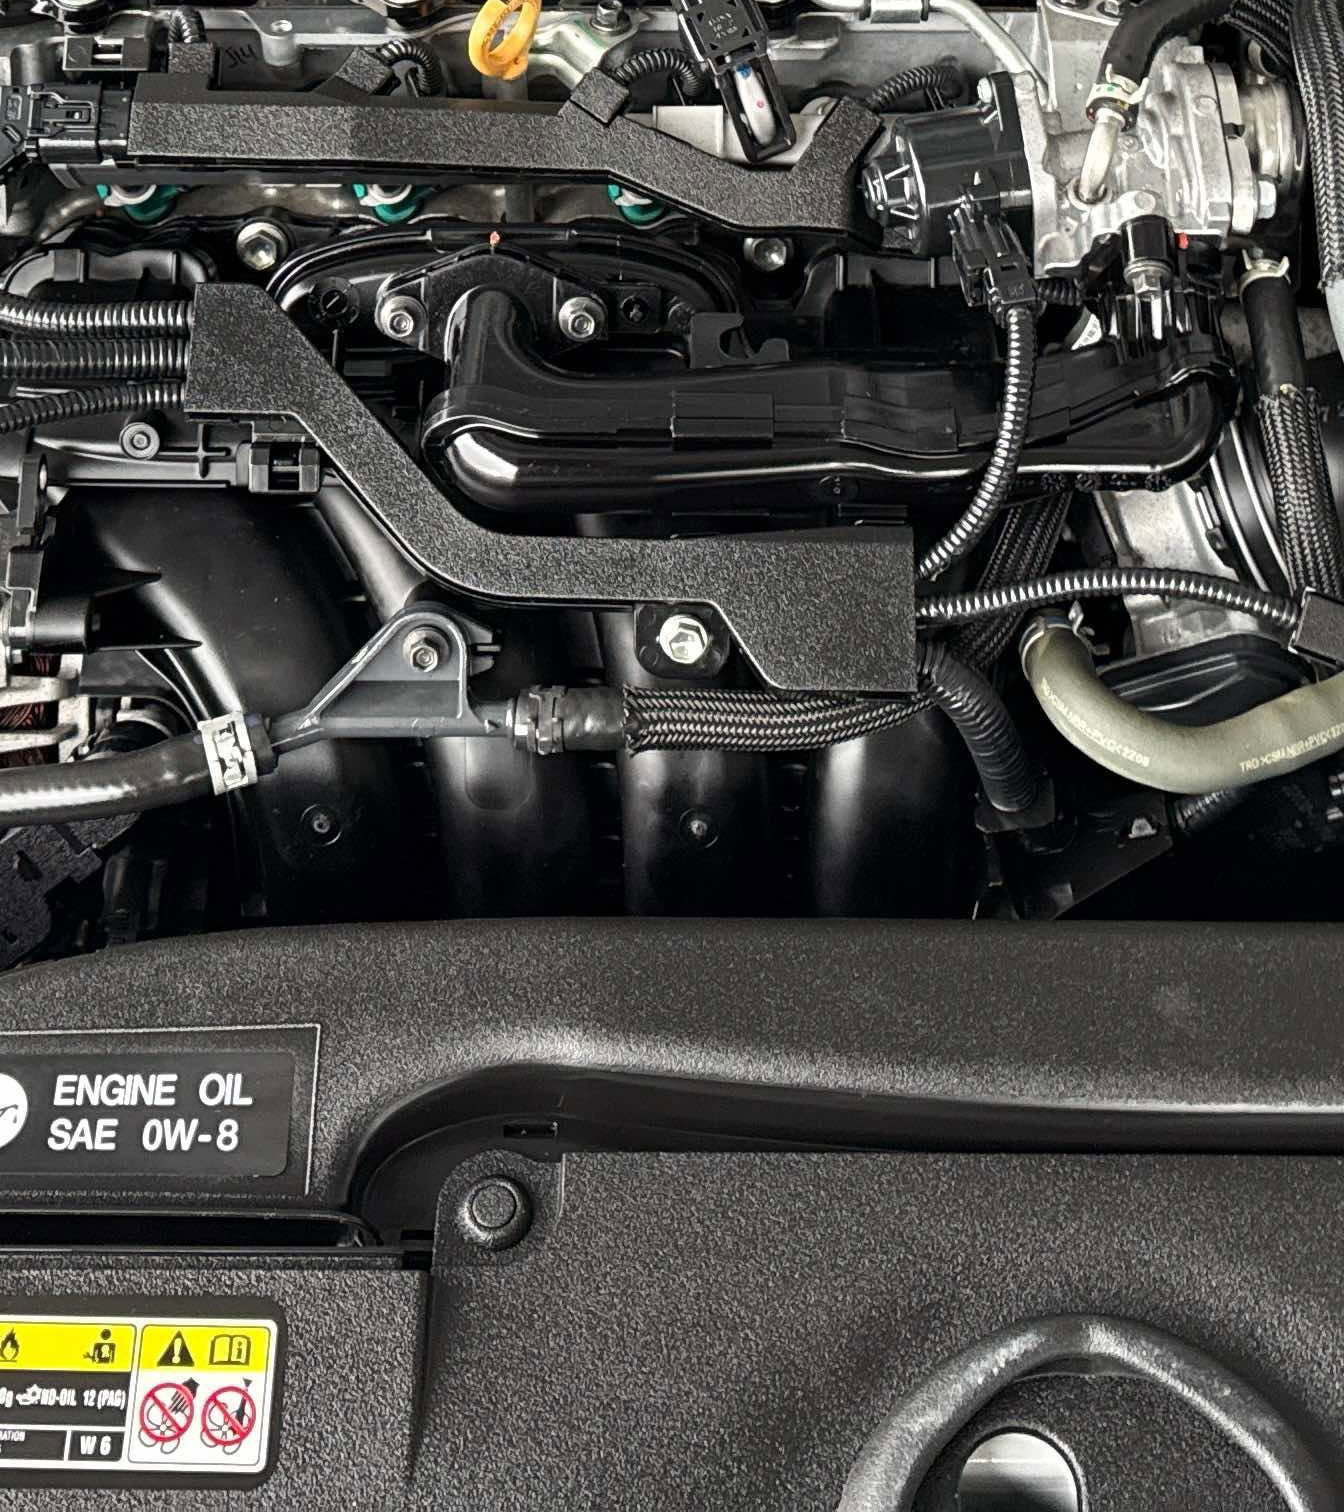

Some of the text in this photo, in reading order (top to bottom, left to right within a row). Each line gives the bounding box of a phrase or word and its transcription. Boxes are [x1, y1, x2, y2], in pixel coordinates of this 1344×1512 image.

[52, 1073, 253, 1107] ENGINE OIL
[46, 1117, 240, 1152] SAE 0W-8
[83, 1390, 96, 1406] 12
[97, 1389, 126, 1410] (PAG)
[80, 1435, 112, 1456] W 6
